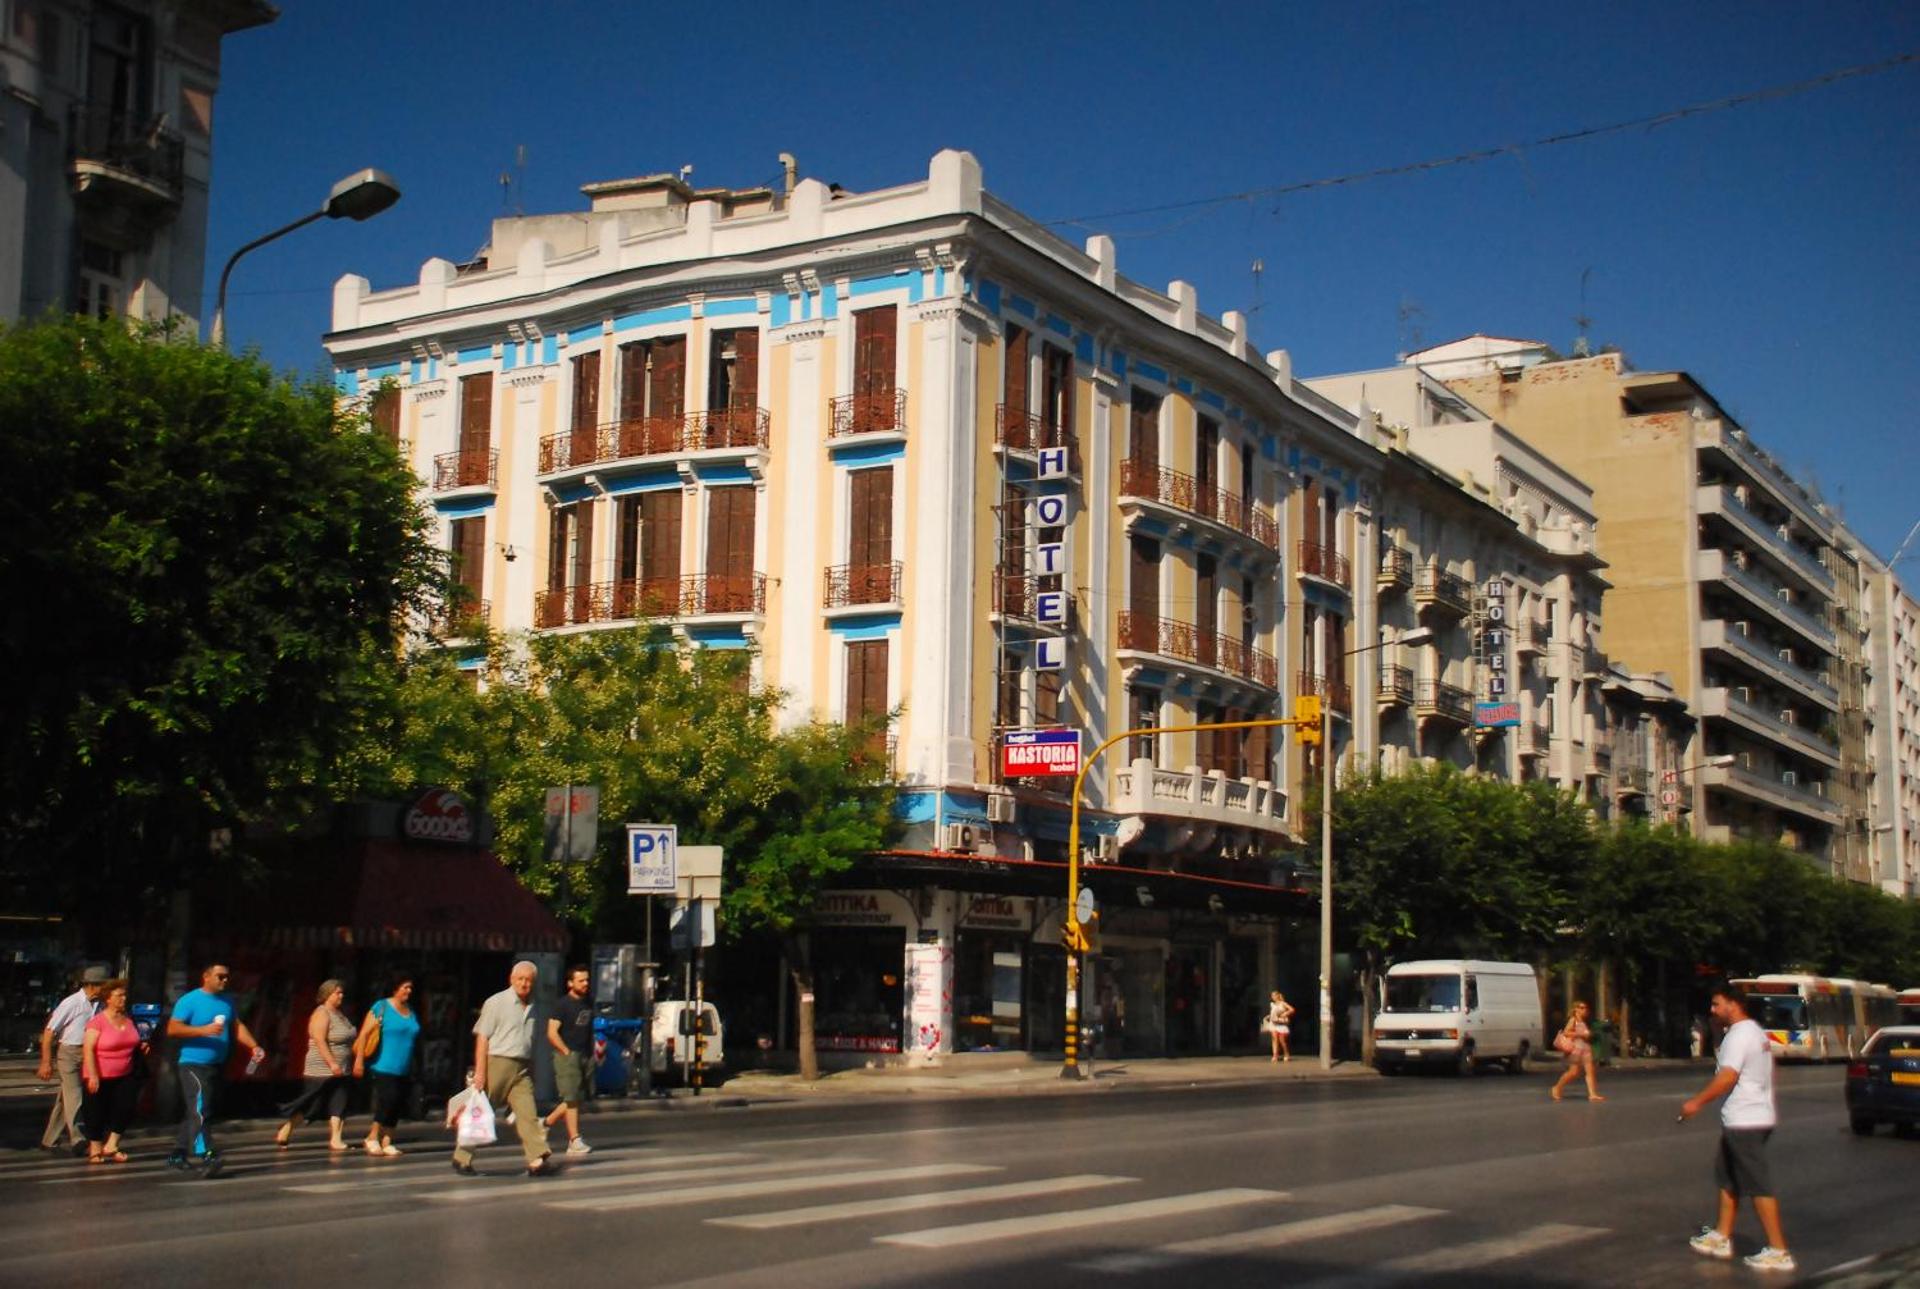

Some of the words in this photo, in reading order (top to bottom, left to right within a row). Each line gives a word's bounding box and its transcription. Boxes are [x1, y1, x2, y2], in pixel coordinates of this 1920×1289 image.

[1039, 450, 1064, 668] HOTEL
[1490, 583, 1503, 692] HOTEL
[1008, 746, 1076, 764] KASTORIA
[1050, 762, 1076, 772] hotel
[633, 833, 655, 864] P
[633, 866, 670, 876] PARKING
